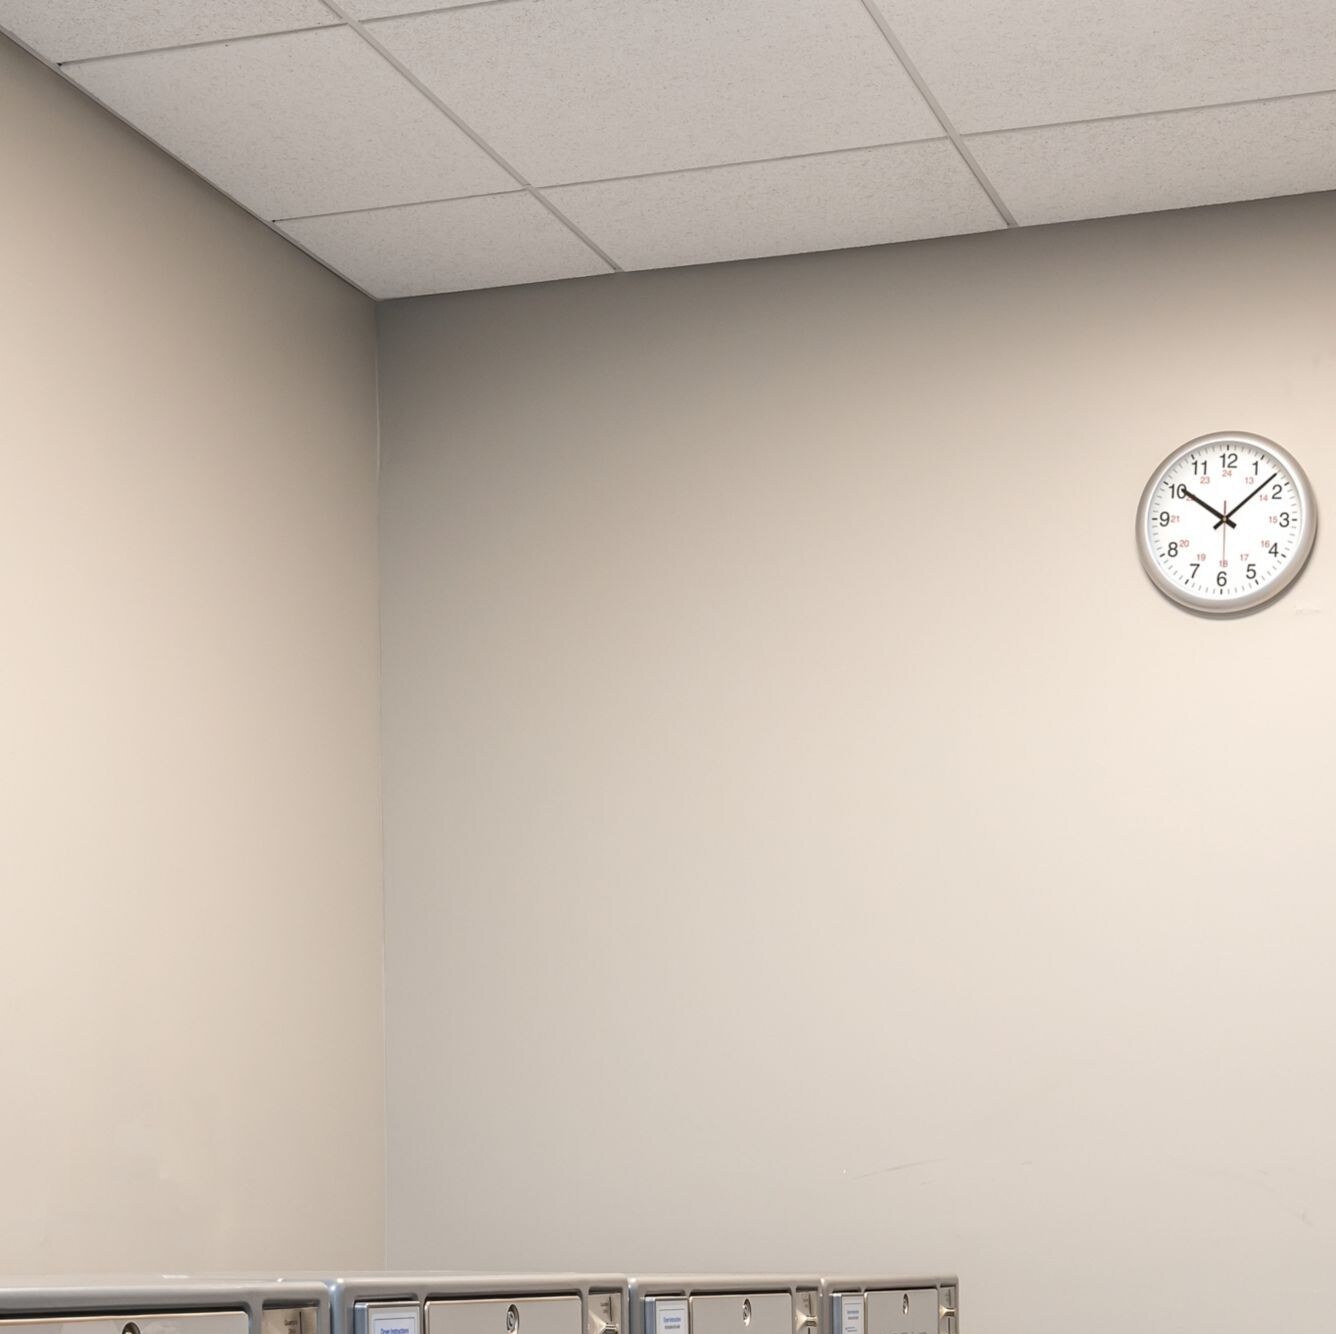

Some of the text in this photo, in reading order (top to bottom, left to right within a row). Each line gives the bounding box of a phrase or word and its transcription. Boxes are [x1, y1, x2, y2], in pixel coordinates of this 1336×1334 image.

[1191, 460, 1207, 475] 11
[1219, 453, 1238, 469] 12
[1252, 461, 1259, 476] 1
[1199, 476, 1211, 485] 23
[1221, 469, 1233, 478] 24
[1244, 476, 1254, 485] 13
[1168, 483, 1187, 500] 10
[1259, 494, 1268, 502] 14
[1271, 484, 1283, 500] 2
[1159, 511, 1170, 527] 9
[1170, 515, 1180, 523] 21
[1279, 512, 1290, 528] 3
[1167, 541, 1178, 558] 8
[1179, 540, 1190, 548] 20
[1261, 540, 1270, 548] 16
[1268, 542, 1279, 557] 4
[1197, 553, 1206, 561] 19
[1240, 553, 1249, 561] 17
[1189, 563, 1200, 579] 7
[1246, 564, 1257, 579] 5
[1216, 571, 1227, 587] 6
